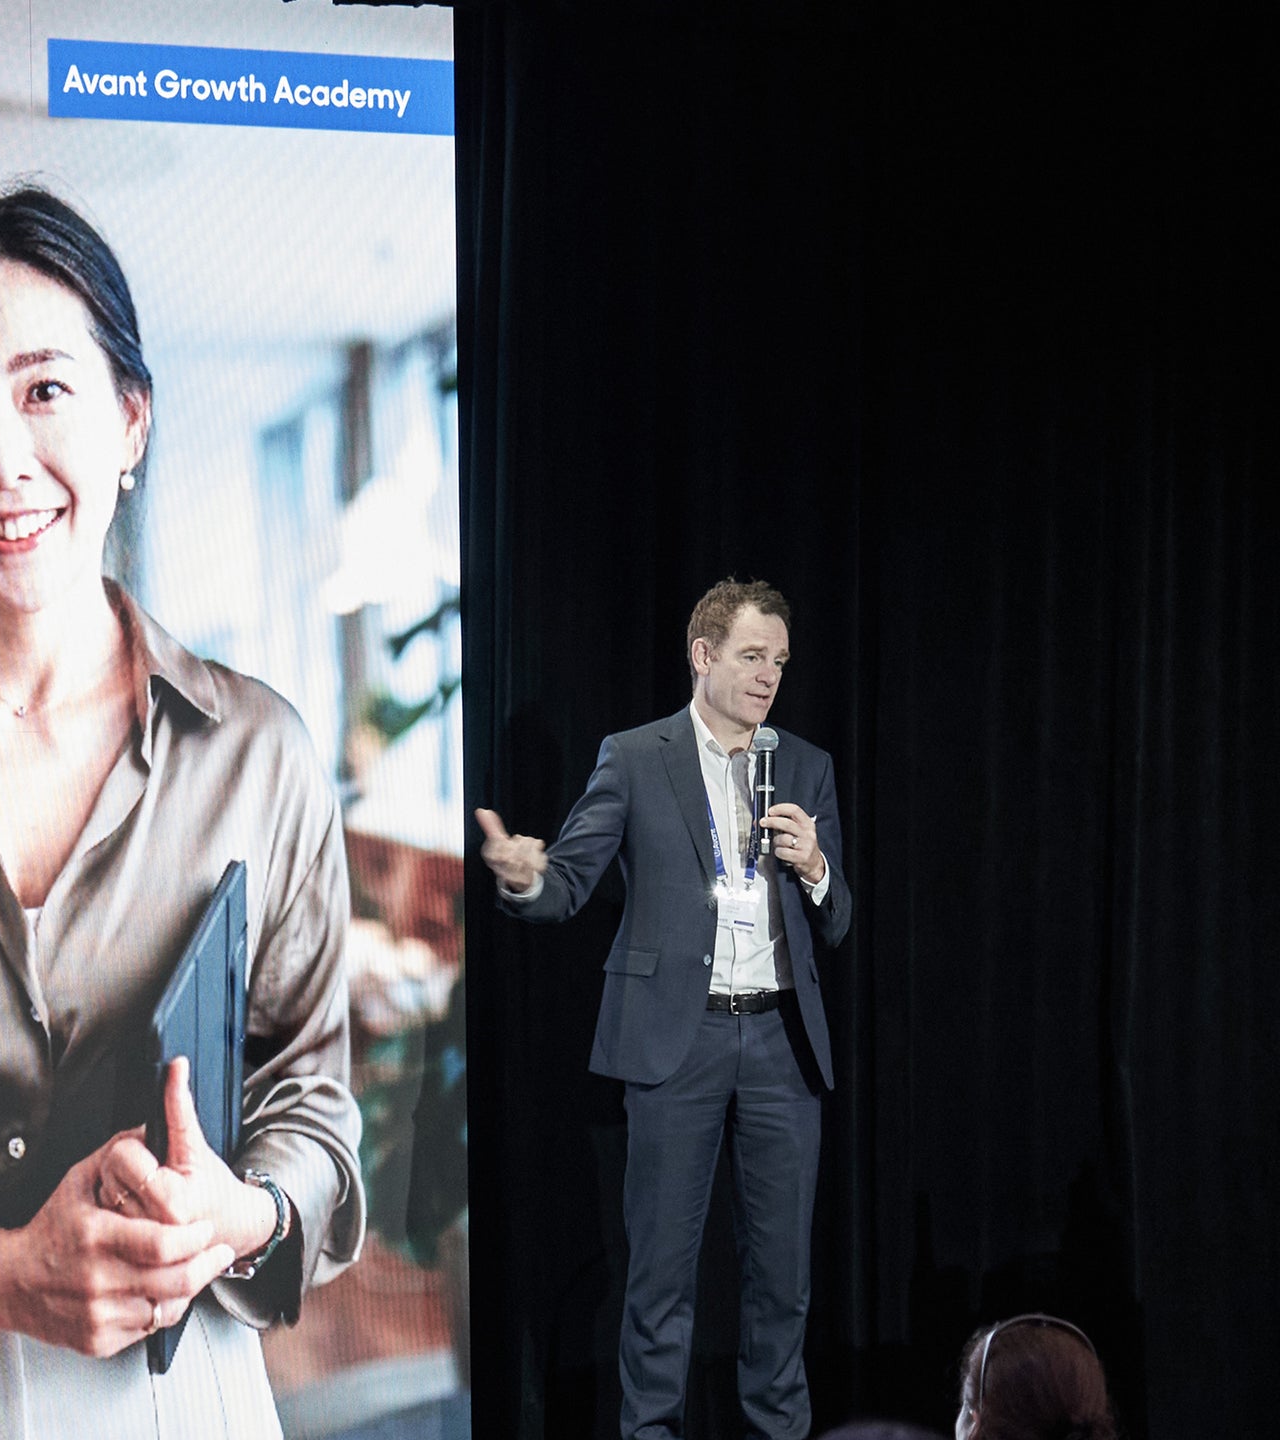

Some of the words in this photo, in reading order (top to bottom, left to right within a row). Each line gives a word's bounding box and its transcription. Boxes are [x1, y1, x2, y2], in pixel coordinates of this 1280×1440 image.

[63, 64, 147, 97] Avant
[154, 69, 266, 103] Growth
[273, 76, 411, 118] Academy
